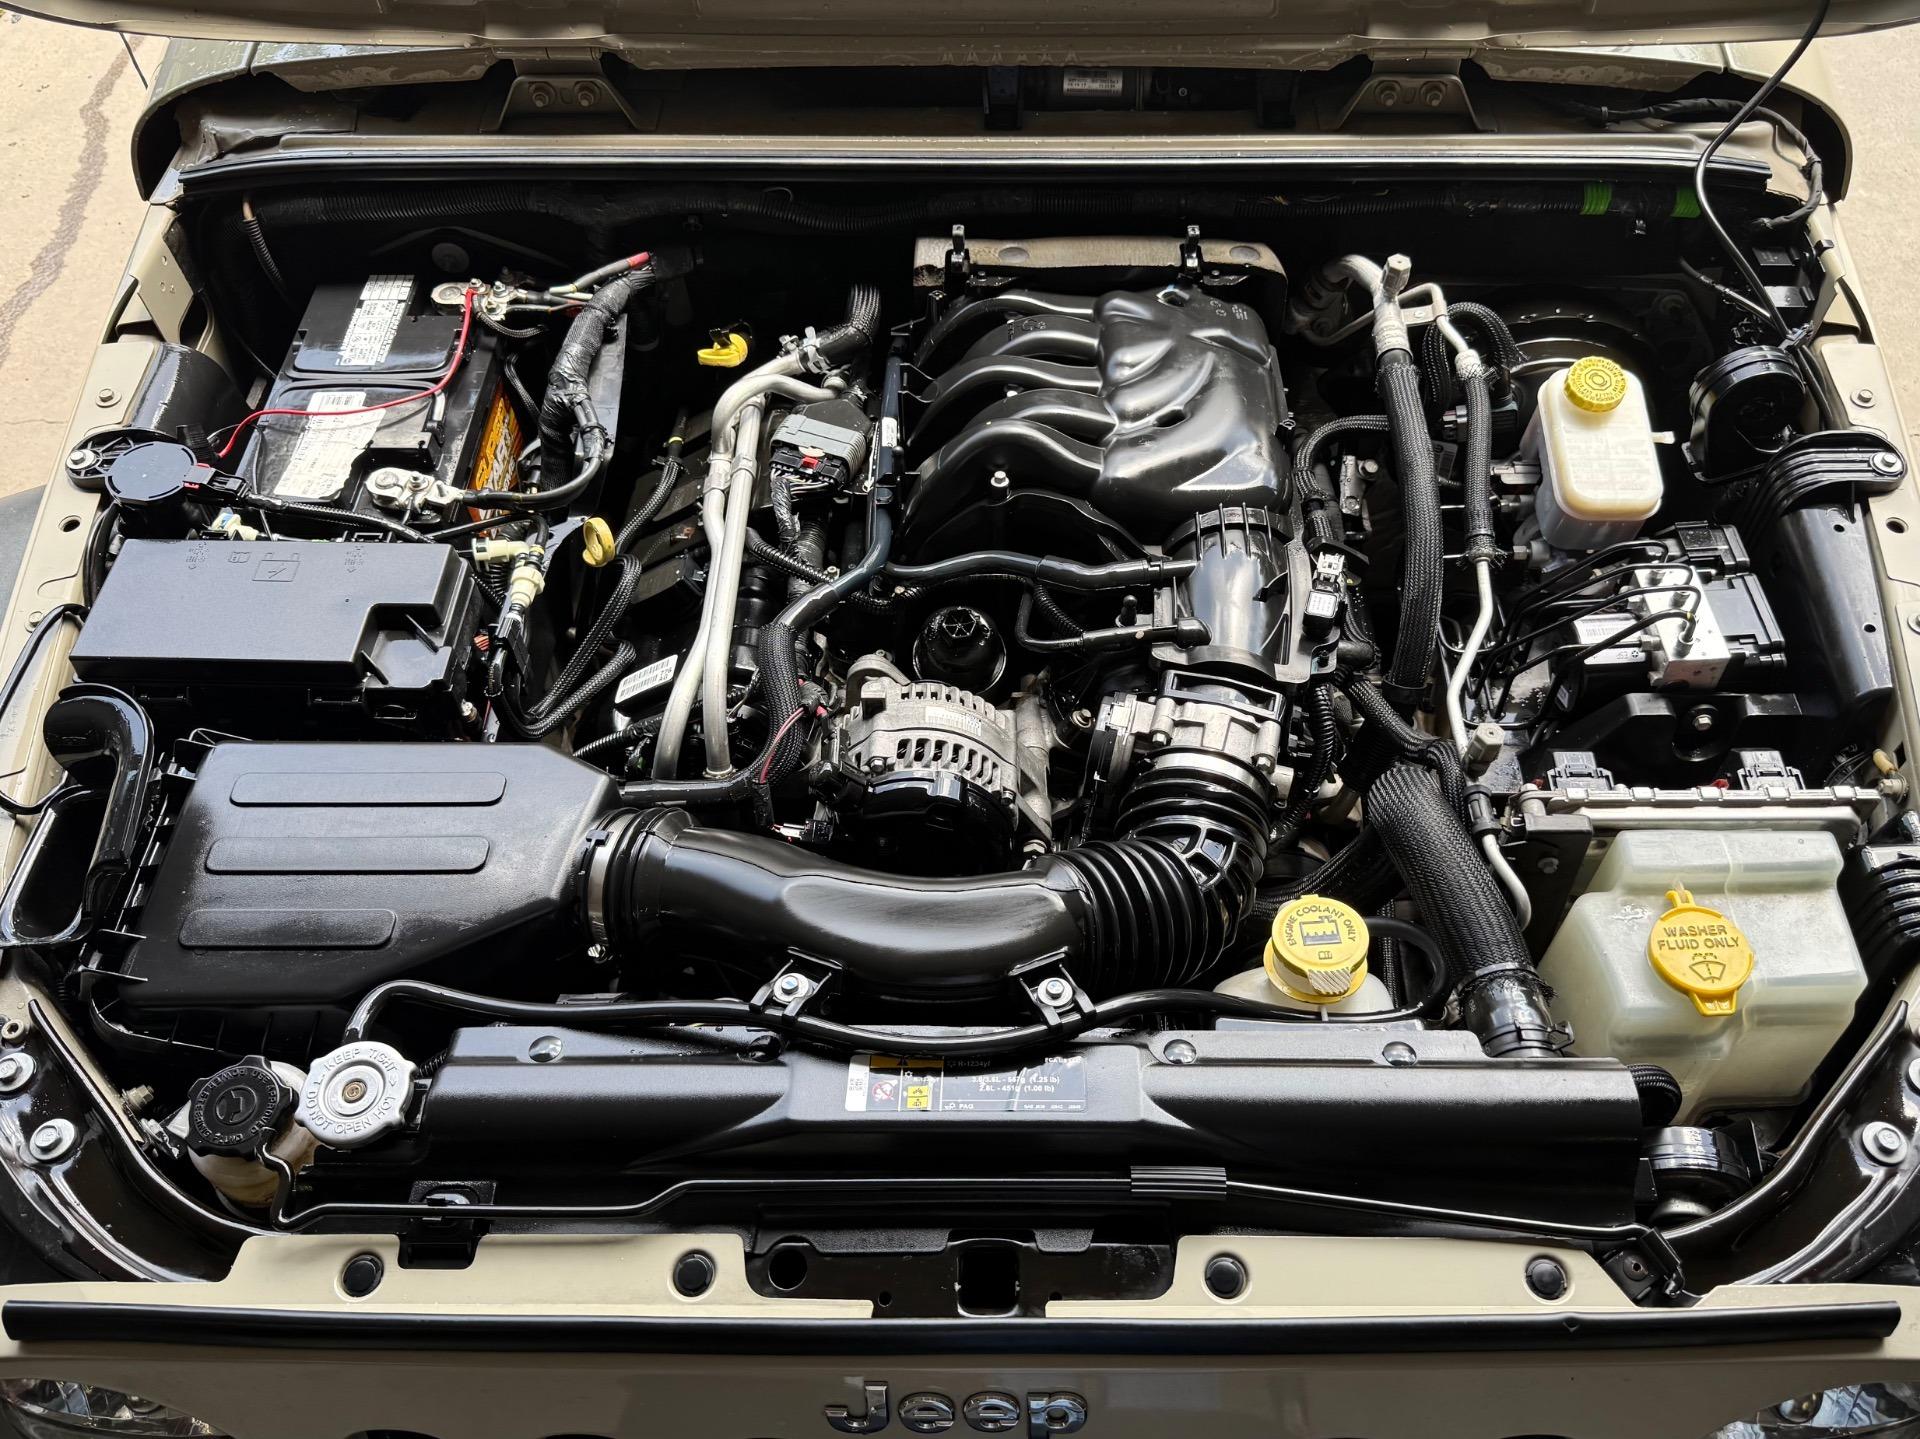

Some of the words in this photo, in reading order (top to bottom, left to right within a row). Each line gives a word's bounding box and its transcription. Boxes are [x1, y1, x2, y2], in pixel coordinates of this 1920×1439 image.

[1285, 915, 1297, 946] ENGINE
[1296, 905, 1345, 919] COOLANT
[1343, 919, 1356, 942] ONLY
[1663, 924, 1728, 937] WASHER
[1657, 939, 1700, 951] FLUID
[1703, 936, 1739, 948] ONLY
[324, 1048, 361, 1072] KEEP
[368, 1048, 398, 1072] TIGHT
[250, 1084, 277, 1135] APPROVED
[306, 1091, 319, 1109] DO
[373, 1096, 396, 1120] HOT
[309, 1110, 334, 1131] NOT
[333, 1119, 372, 1135] OPEN
[824, 1380, 1088, 1439] Jeep
